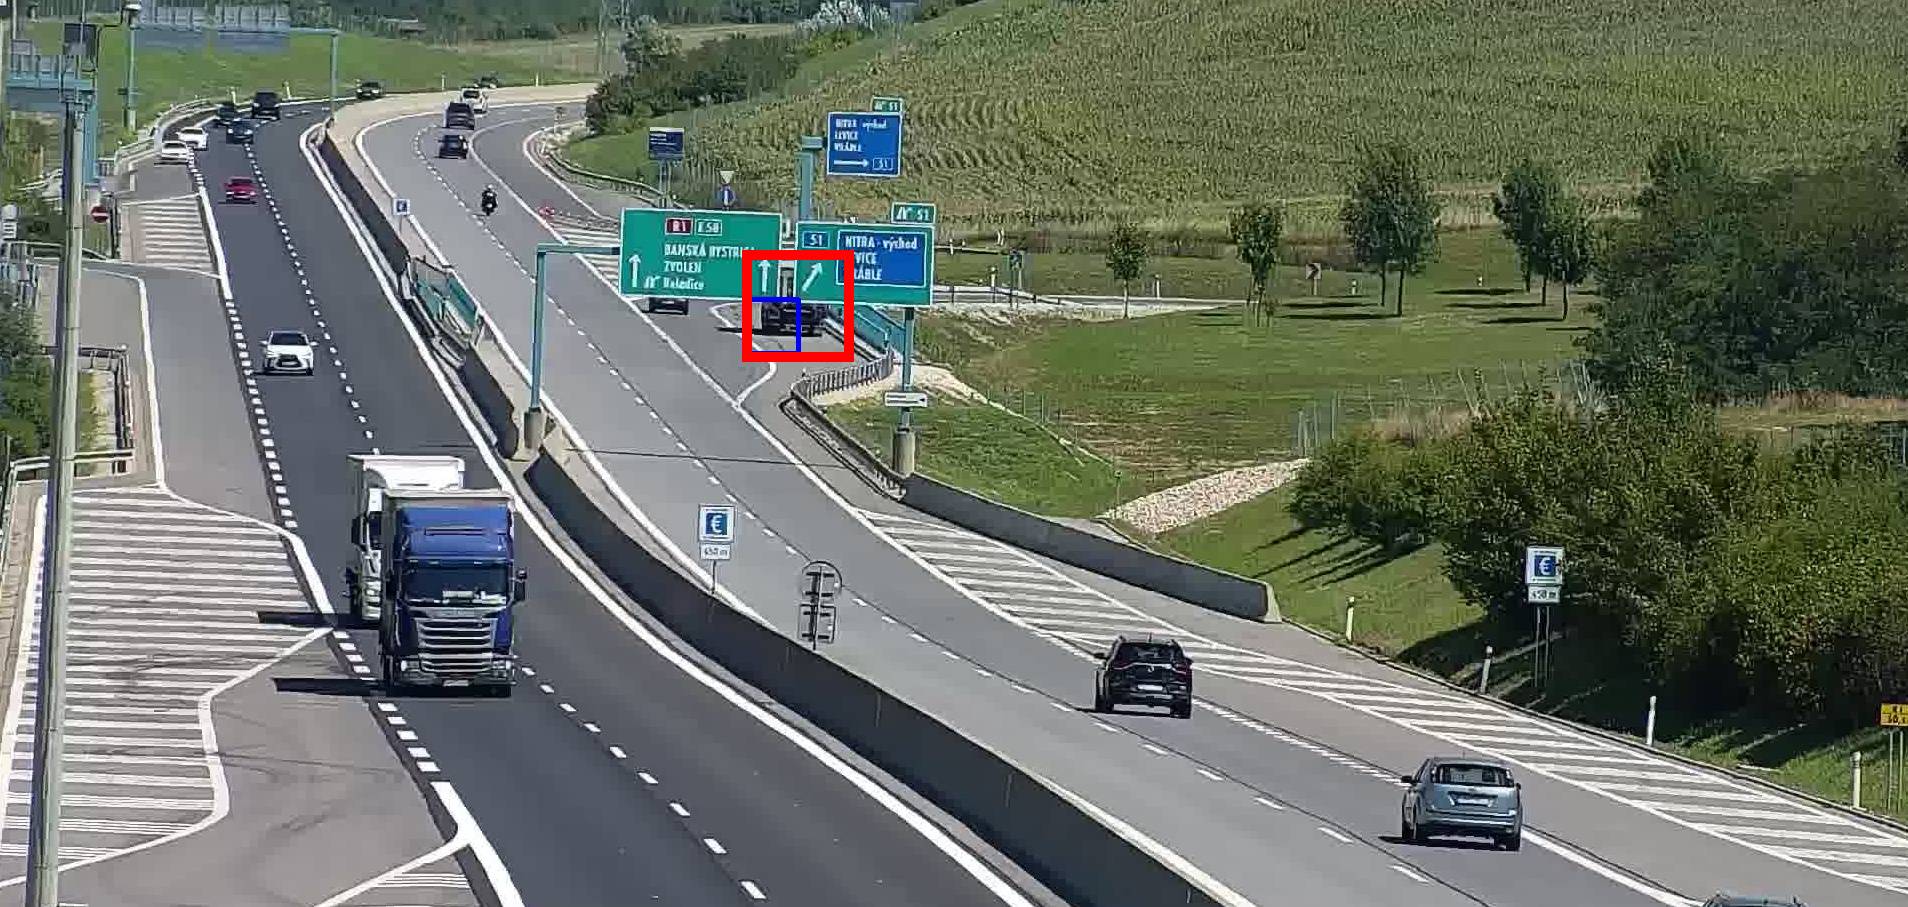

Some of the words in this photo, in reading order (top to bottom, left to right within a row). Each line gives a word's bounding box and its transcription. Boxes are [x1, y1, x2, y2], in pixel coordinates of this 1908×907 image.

[673, 220, 686, 232] R1
[809, 233, 823, 246] 51
[845, 235, 876, 248] NITRA
[882, 236, 918, 252] východ
[664, 241, 707, 257] BANSKÁ
[854, 251, 878, 264] VICE
[664, 260, 702, 273] ZVOLEN
[853, 265, 882, 280] RÁBLE
